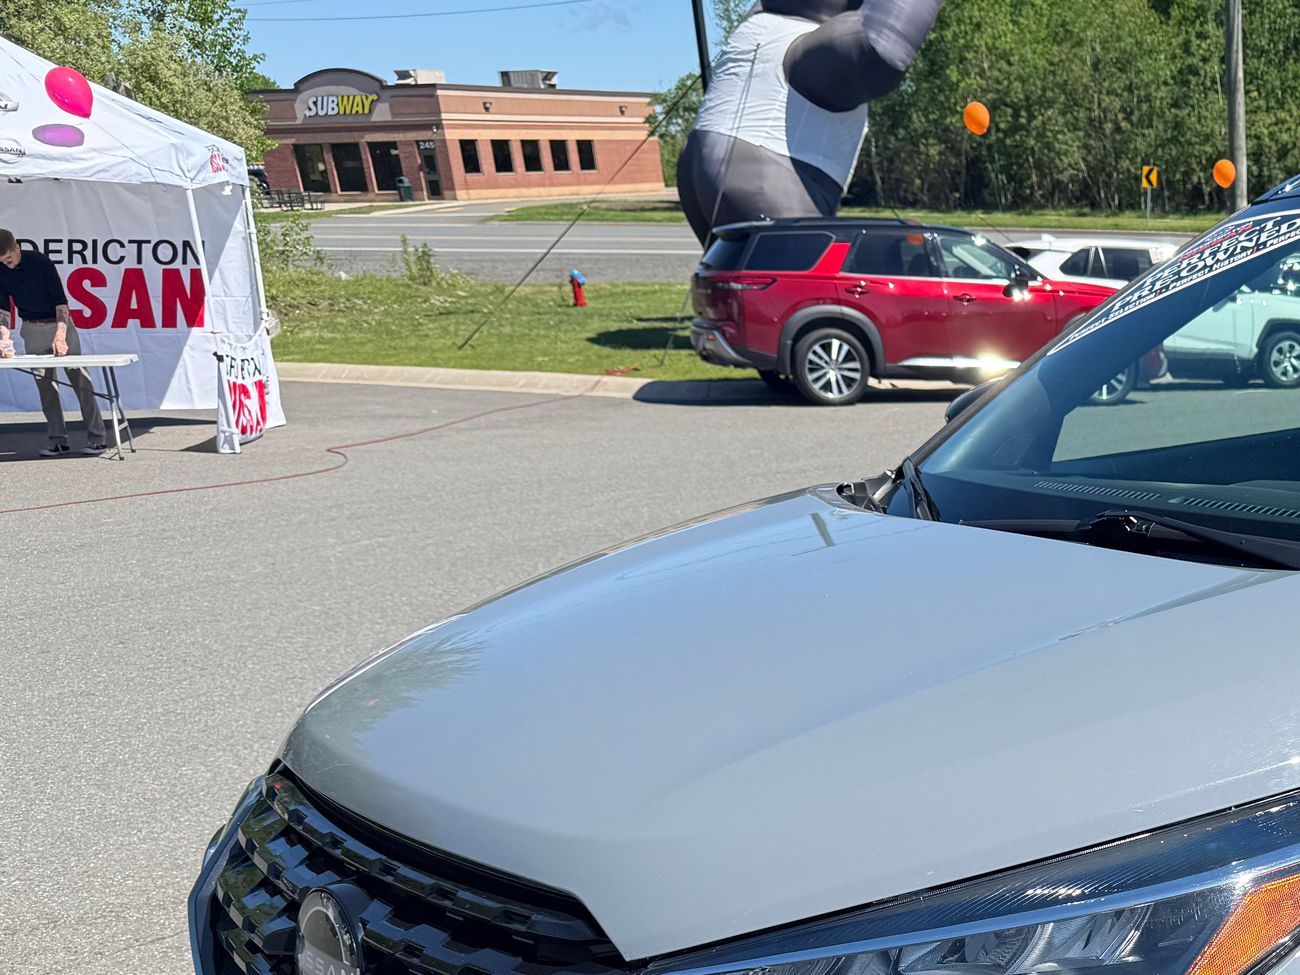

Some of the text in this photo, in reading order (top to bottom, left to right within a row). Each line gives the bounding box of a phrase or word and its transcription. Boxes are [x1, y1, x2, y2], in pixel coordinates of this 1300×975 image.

[304, 92, 378, 118] SUBWAY
[418, 141, 435, 150] 245
[1143, 216, 1282, 289] PERFECT
[9, 267, 206, 329] SAN
